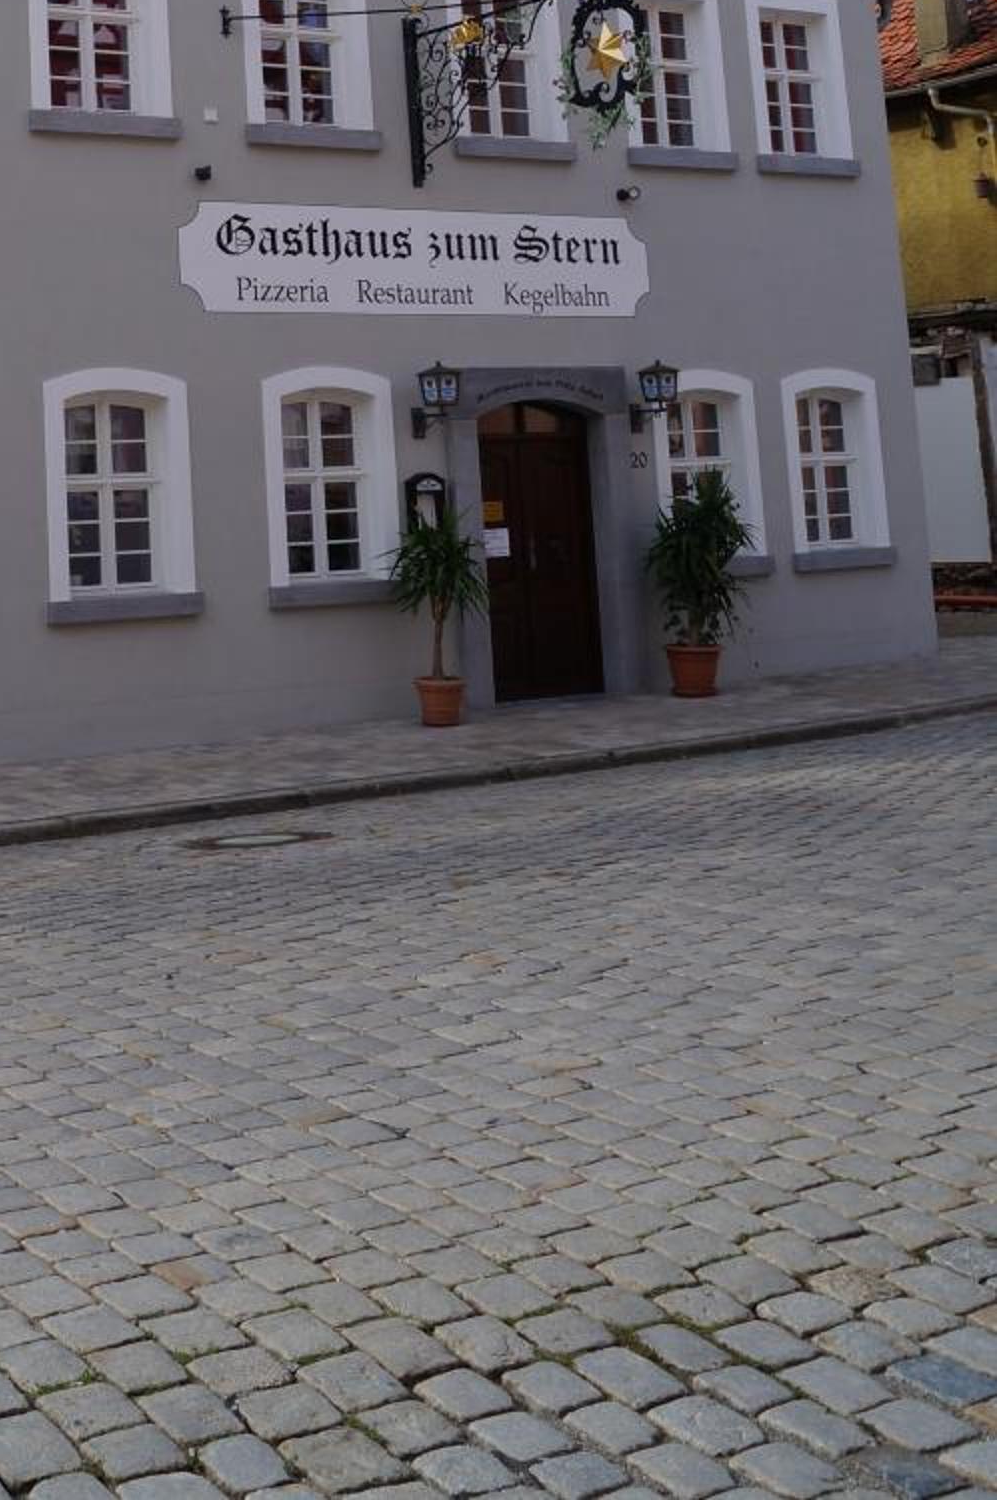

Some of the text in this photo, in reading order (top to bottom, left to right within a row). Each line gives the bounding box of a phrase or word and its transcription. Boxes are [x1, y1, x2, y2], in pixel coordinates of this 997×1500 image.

[216, 213, 621, 268] Gasthaus zum Stern
[236, 276, 611, 314] Pizzeria Restaurant Kegelbahn
[629, 451, 649, 469] 20
